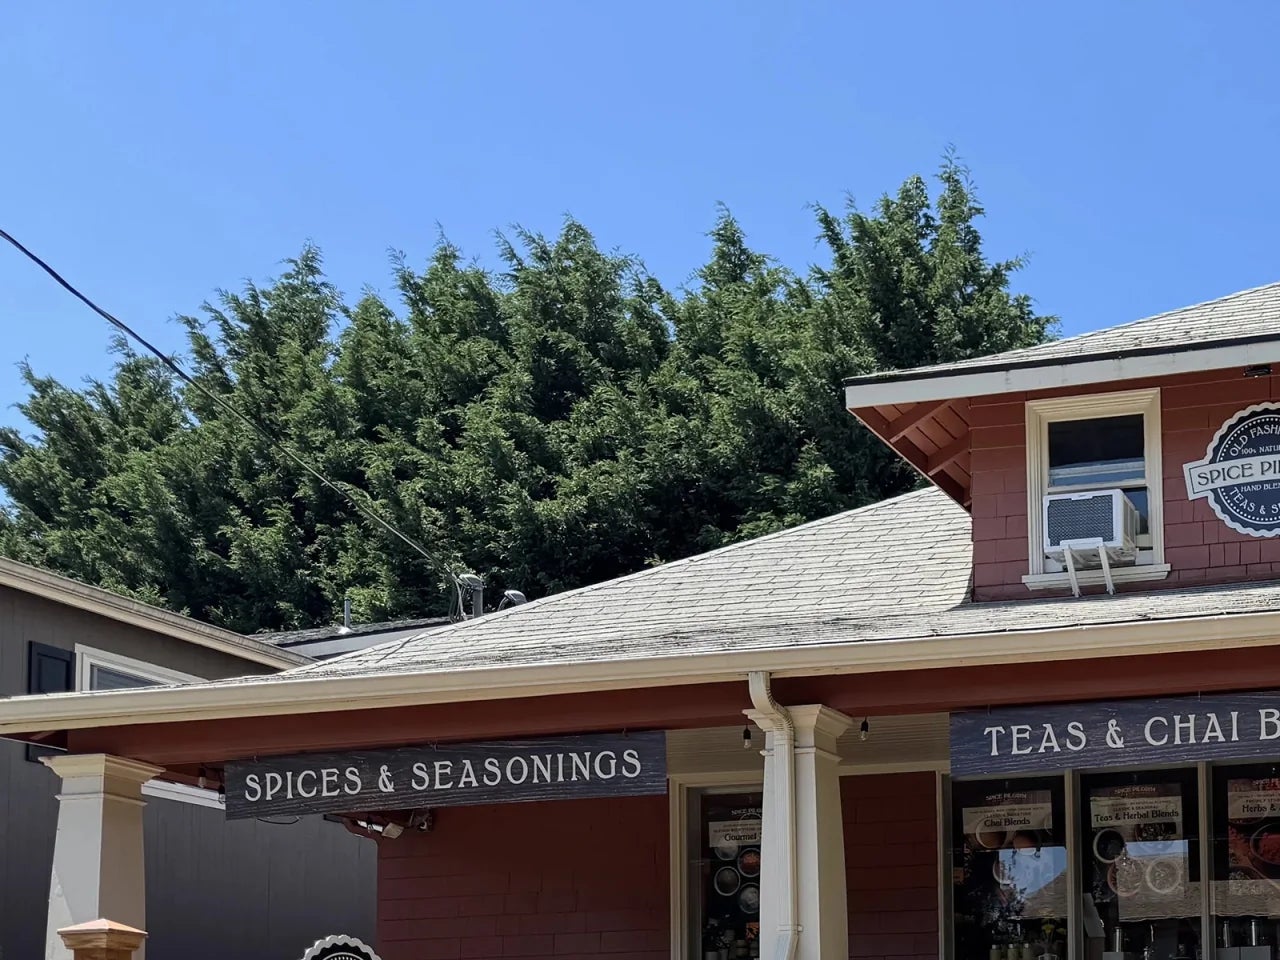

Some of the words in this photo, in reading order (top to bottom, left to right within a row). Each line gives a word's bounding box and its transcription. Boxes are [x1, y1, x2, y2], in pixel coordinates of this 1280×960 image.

[1230, 435, 1248, 456] OLD
[1197, 463, 1253, 486] SPICE
[1240, 483, 1262, 493] HAND
[1229, 487, 1256, 513] TEAS
[1260, 505, 1266, 515] &
[983, 722, 1087, 757] TEAS
[1106, 718, 1125, 749] &
[1144, 710, 1240, 747] CHAI
[244, 767, 362, 802] SPICES
[377, 764, 395, 794] &
[411, 749, 642, 792] SEASONINGS
[1094, 814, 1113, 822] Teas
[1115, 813, 1121, 821] &
[1123, 811, 1149, 820] Herbal
[1151, 809, 1179, 818] Blends
[1242, 804, 1267, 813] Herbs
[1270, 803, 1276, 811] &
[1004, 817, 1031, 826] Blends
[724, 832, 757, 841] Gourmet
